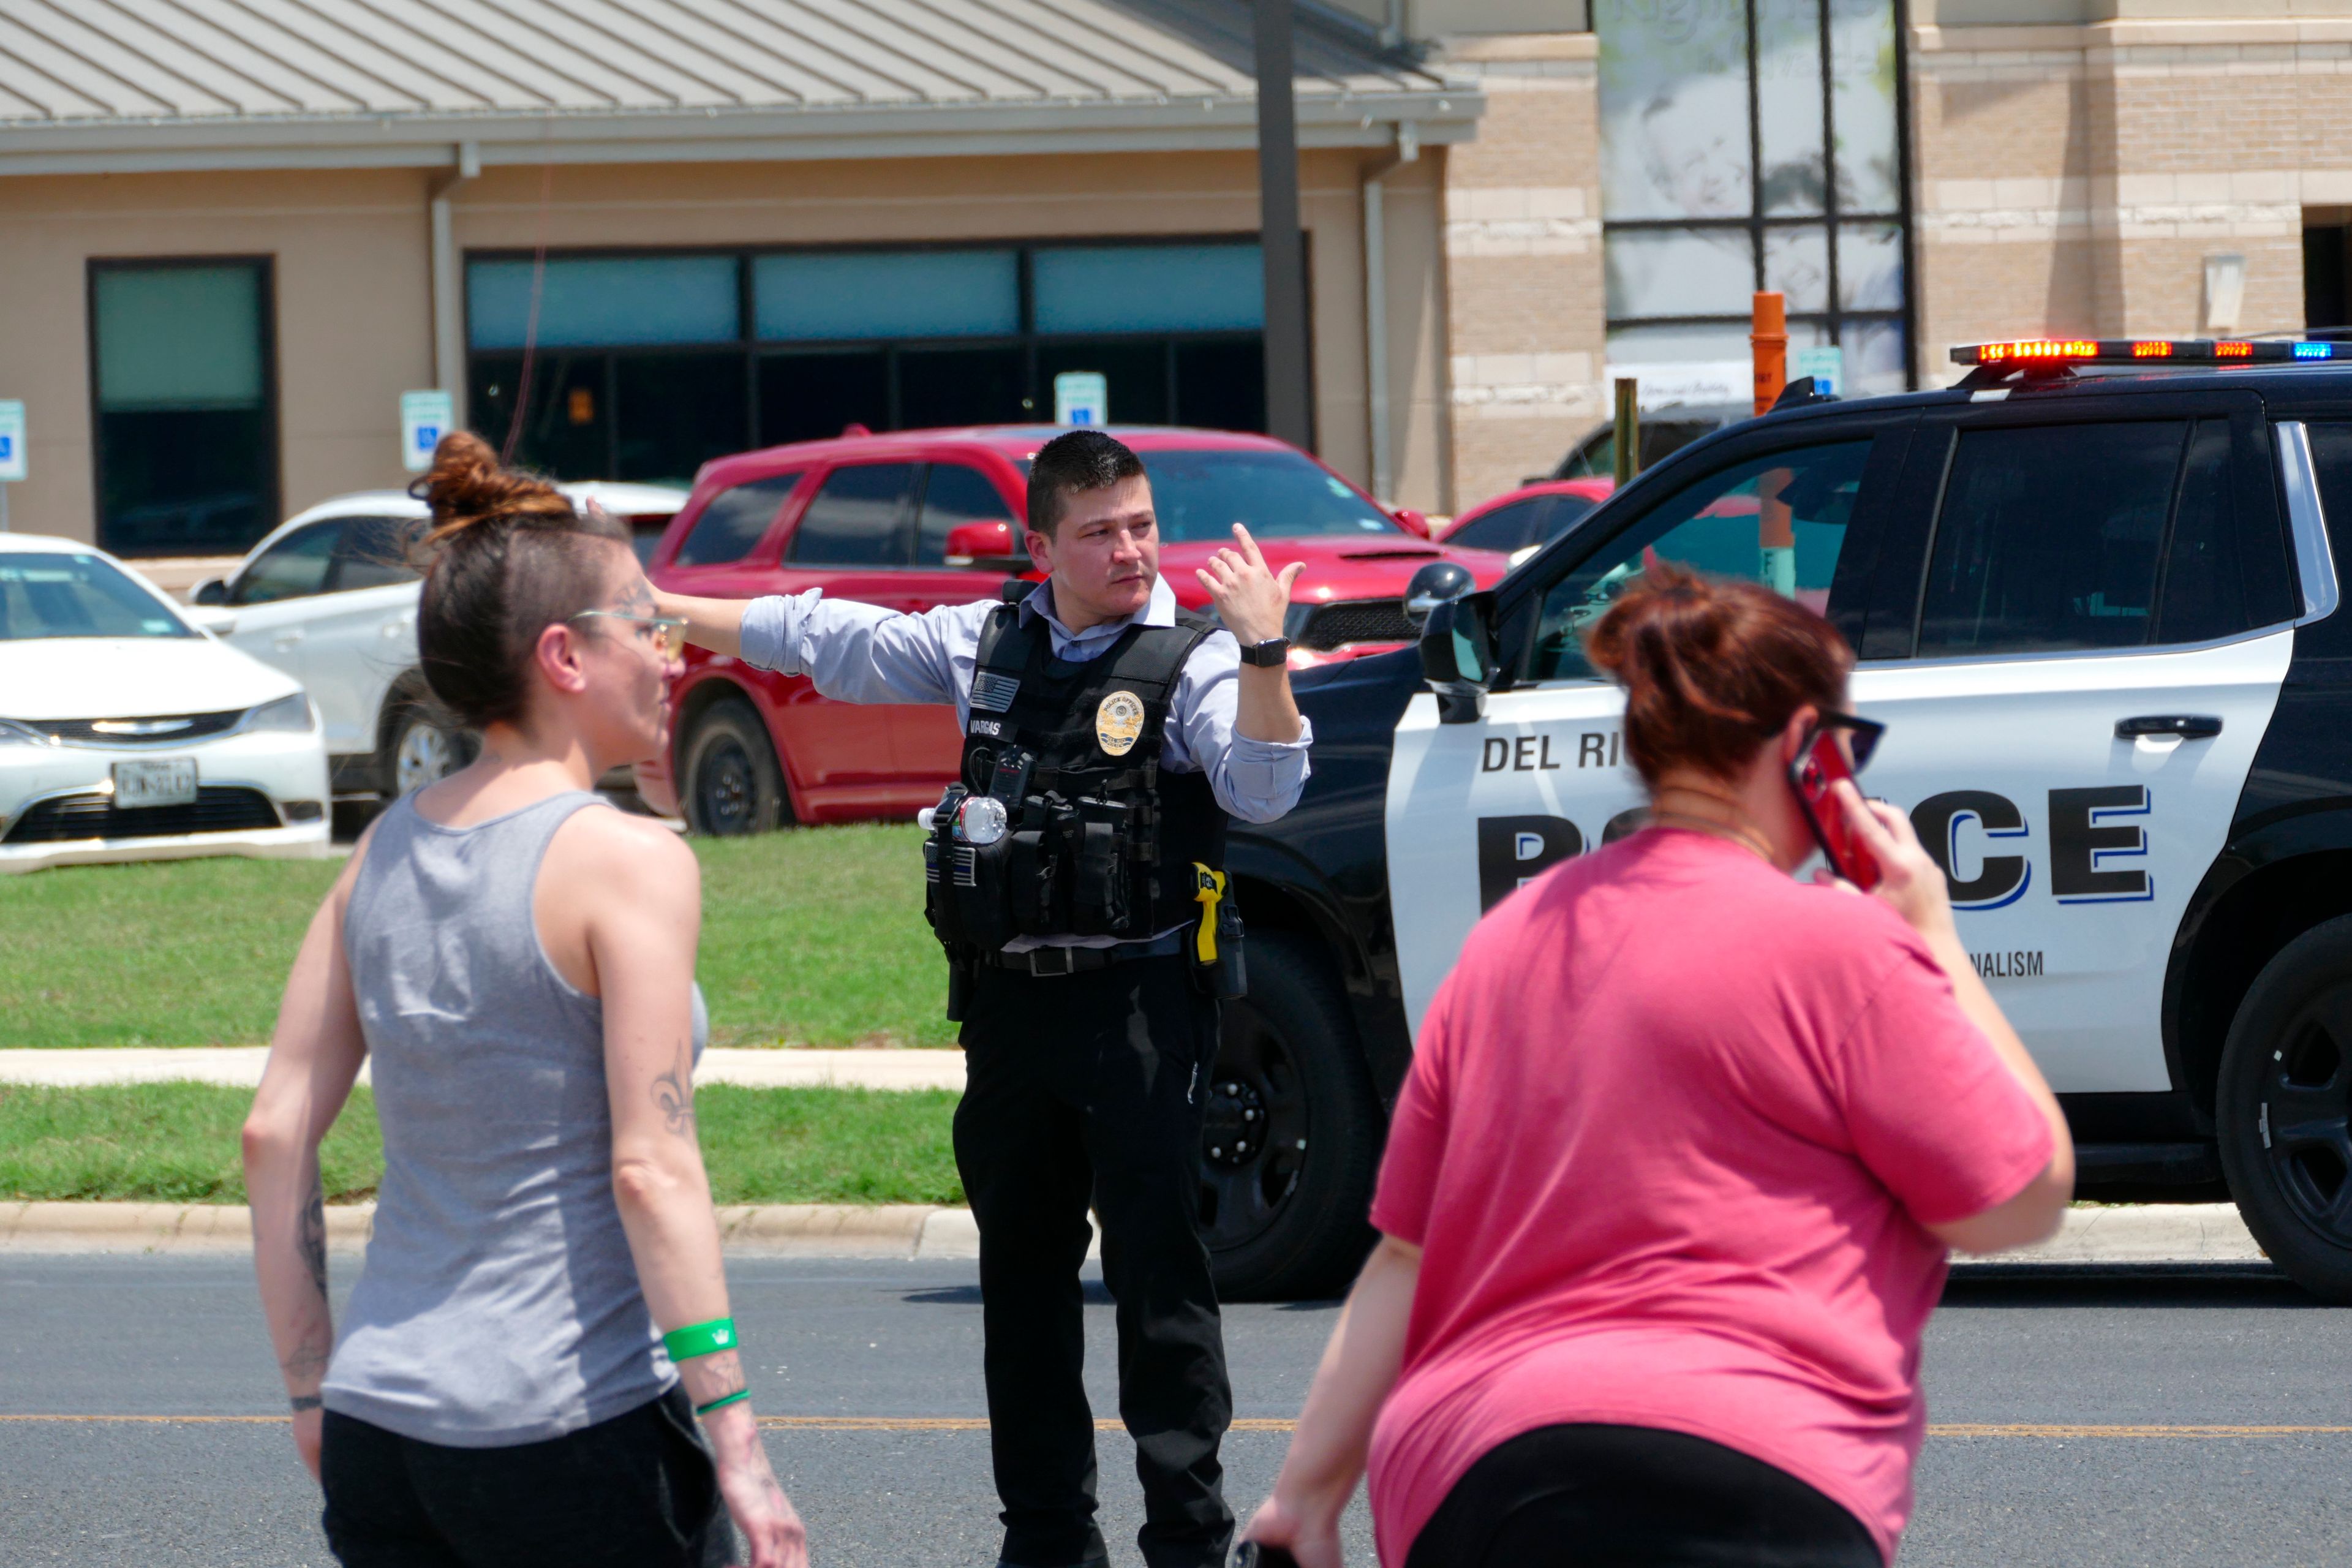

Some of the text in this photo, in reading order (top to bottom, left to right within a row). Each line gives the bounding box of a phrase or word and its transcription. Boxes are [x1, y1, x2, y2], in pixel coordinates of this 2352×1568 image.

[970, 720, 1001, 736] VARGAS
[1482, 732, 1619, 772] DEL RI
[1969, 951, 2043, 978] NALISM
